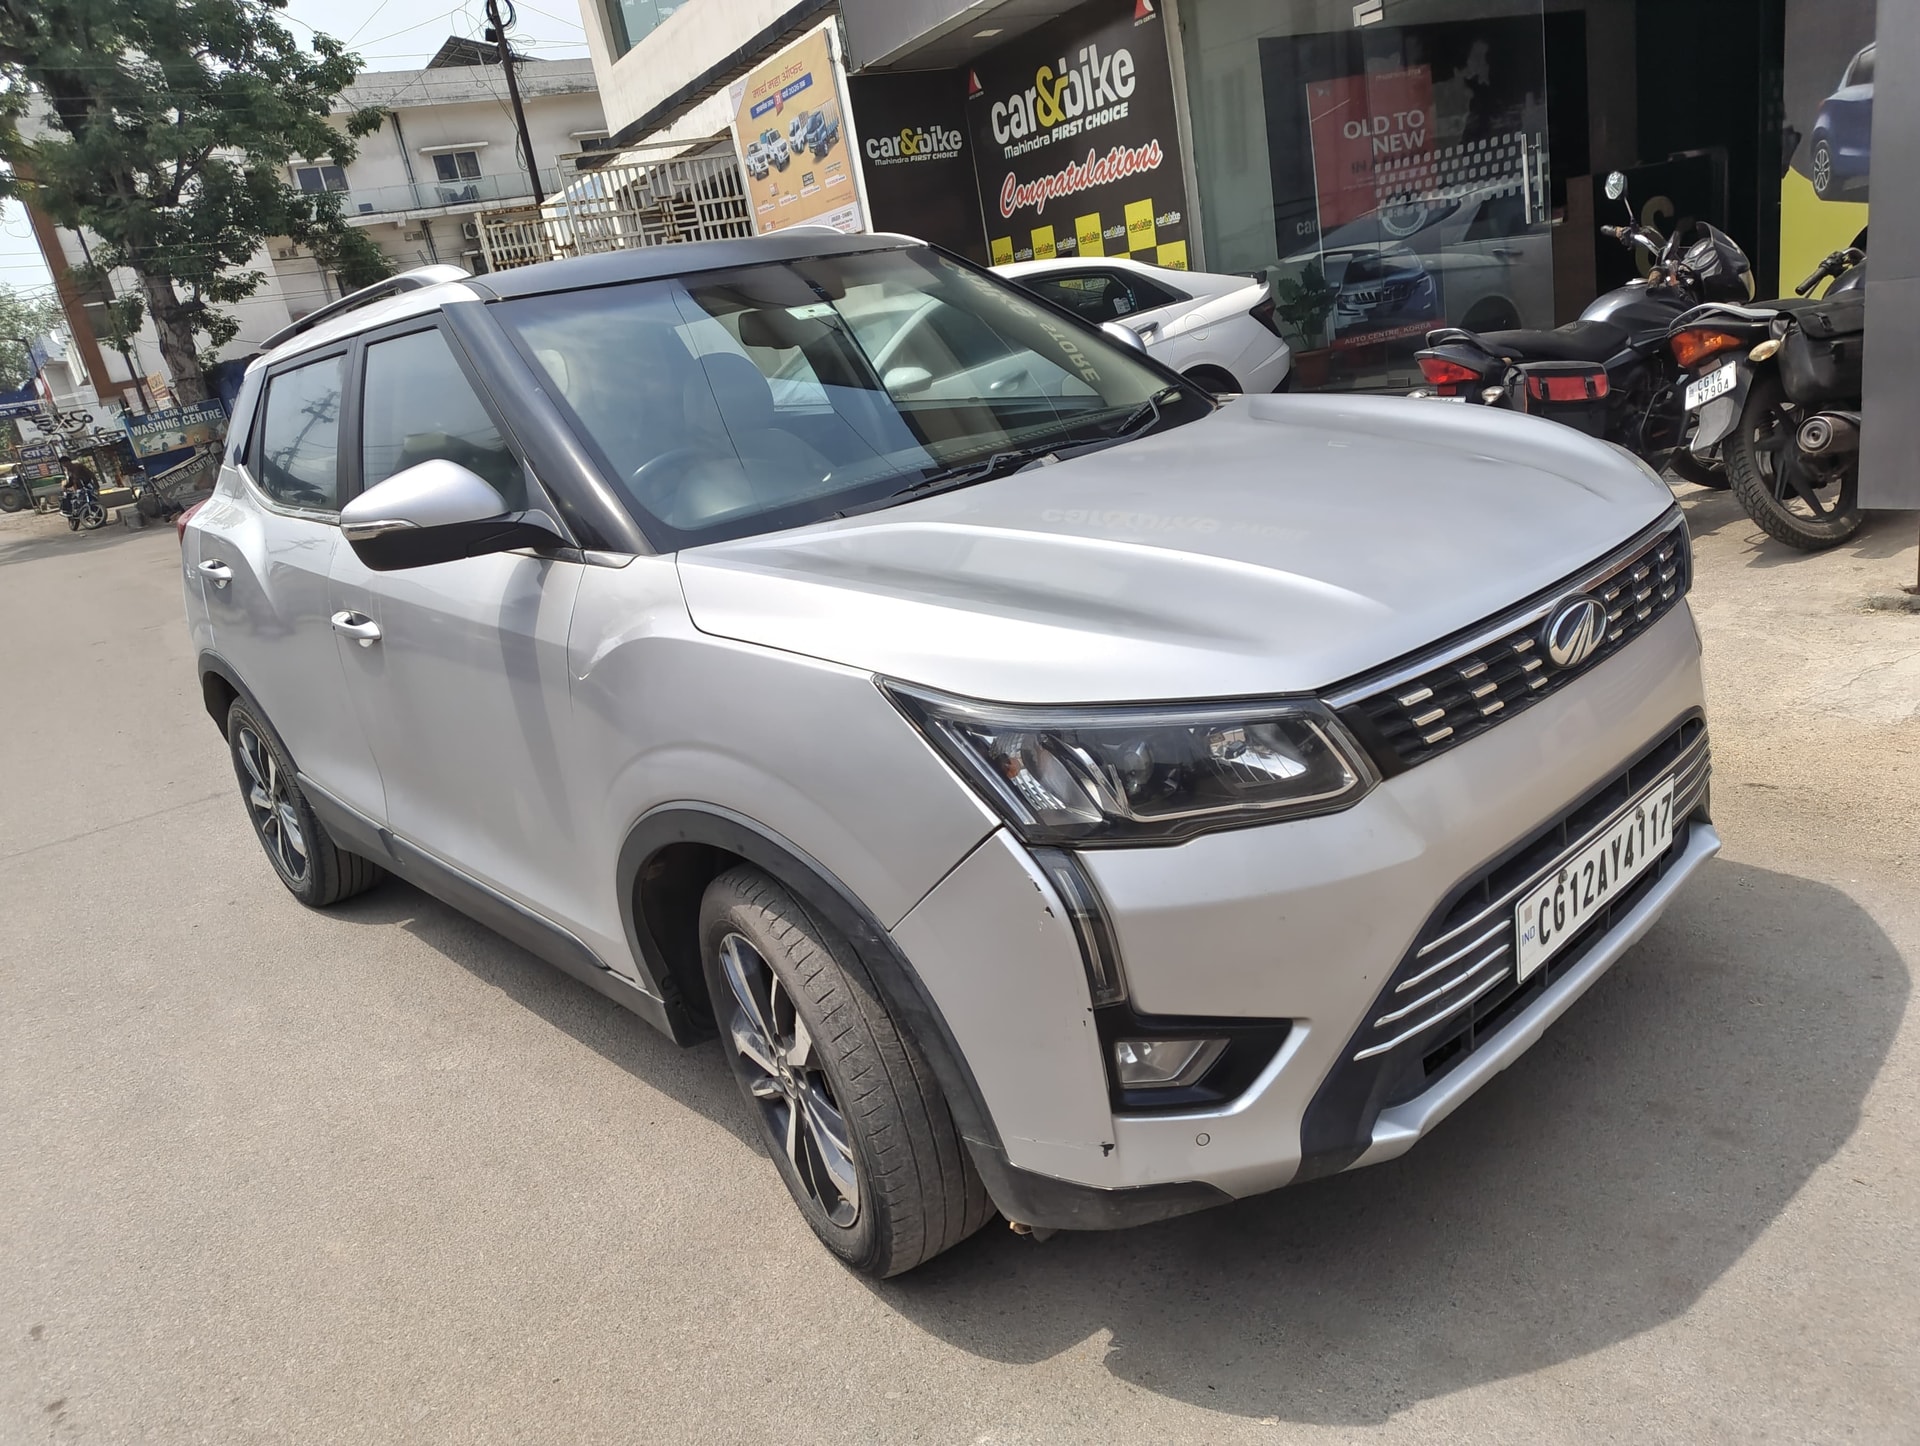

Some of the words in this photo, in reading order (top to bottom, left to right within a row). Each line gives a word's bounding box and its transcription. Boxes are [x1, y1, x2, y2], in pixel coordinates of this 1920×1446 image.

[991, 43, 1136, 145] car&bike
[1052, 119, 1084, 143] FIRST
[1085, 102, 1129, 131] CHOICE
[1343, 116, 1390, 140] OLD
[1393, 109, 1425, 130] TO
[866, 125, 962, 159] car&bike
[910, 153, 932, 162] FIRST
[932, 151, 959, 160] CHOICE
[1373, 129, 1426, 156] NEW
[1000, 138, 1164, 218] Congratulations
[1344, 335, 1366, 345] AUTO
[1404, 322, 1432, 333] KORBA
[1698, 370, 1722, 391] CG12
[130, 418, 181, 437] WASHING
[182, 408, 223, 426] CENTRE
[183, 404, 200, 414] BIKE
[155, 469, 191, 490] WASHING
[188, 454, 215, 475] CENTRE
[1539, 791, 1673, 945] CG12AY4117
[1521, 925, 1536, 947] IND
